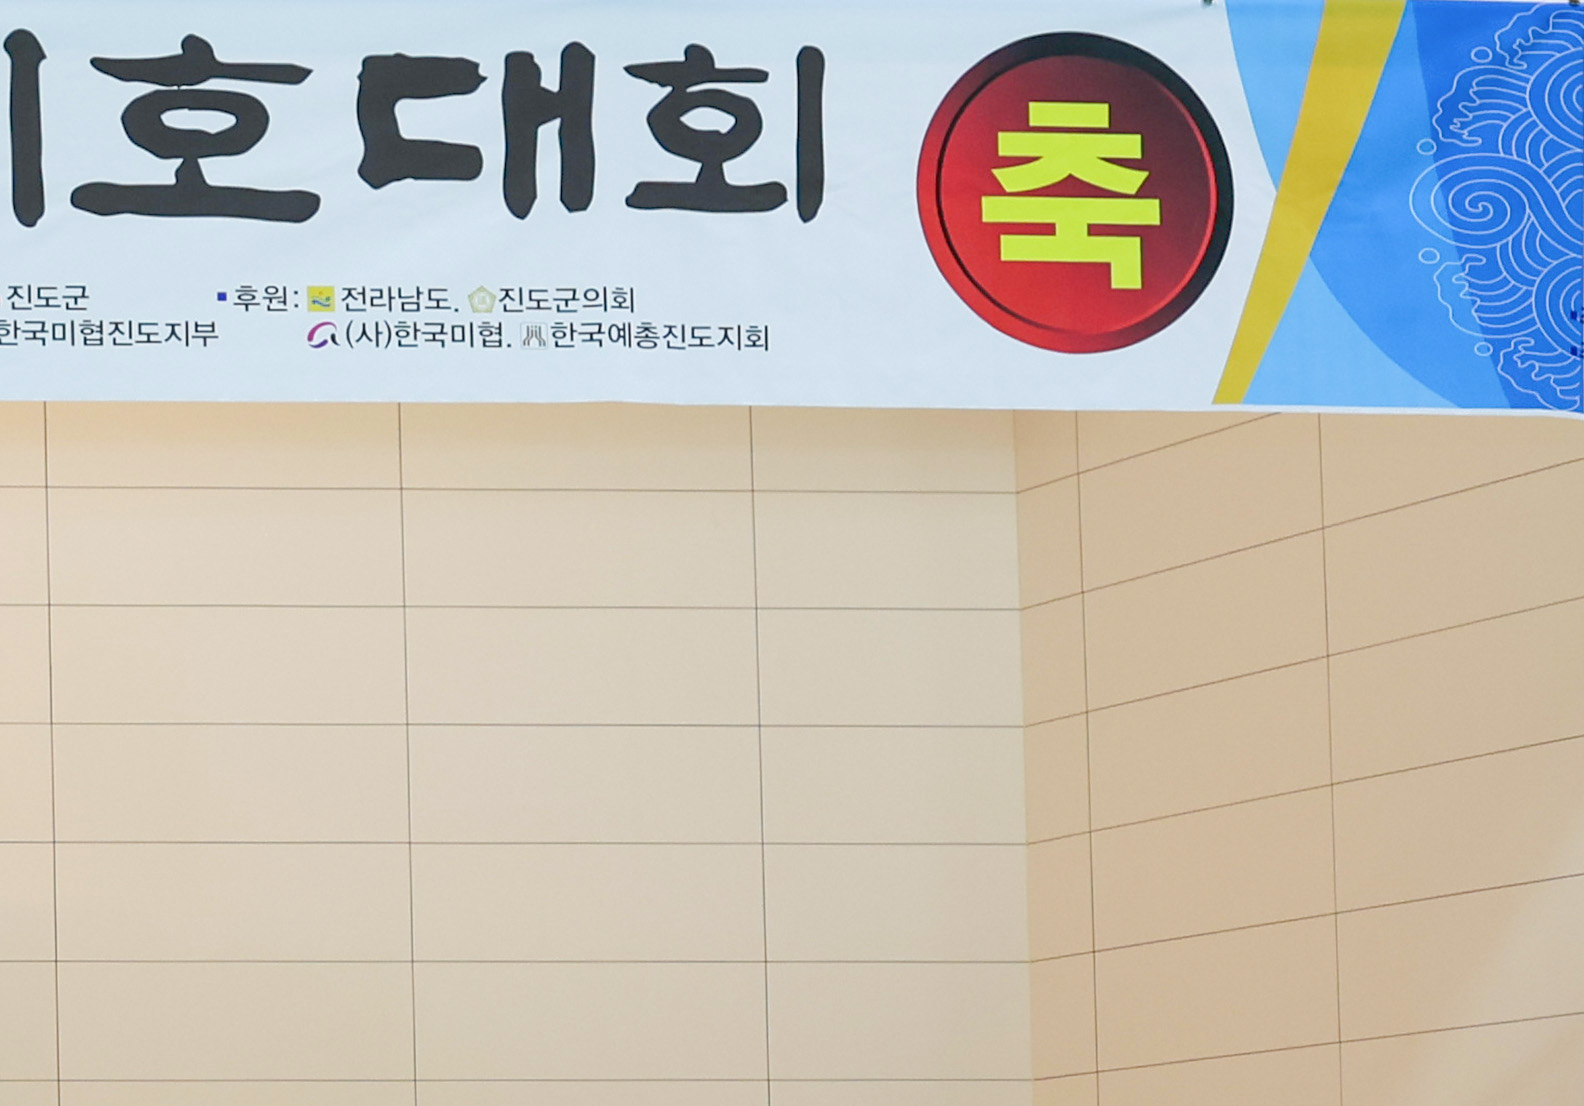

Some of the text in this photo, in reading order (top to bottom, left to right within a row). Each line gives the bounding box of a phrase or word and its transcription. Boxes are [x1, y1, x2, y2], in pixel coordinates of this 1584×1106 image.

[981, 101, 1161, 289] 축
[7, 285, 89, 311] 진도군
[233, 286, 299, 312] 후원:
[498, 286, 635, 313] 진도군의회
[550, 322, 770, 351] 한국예총진도지회
